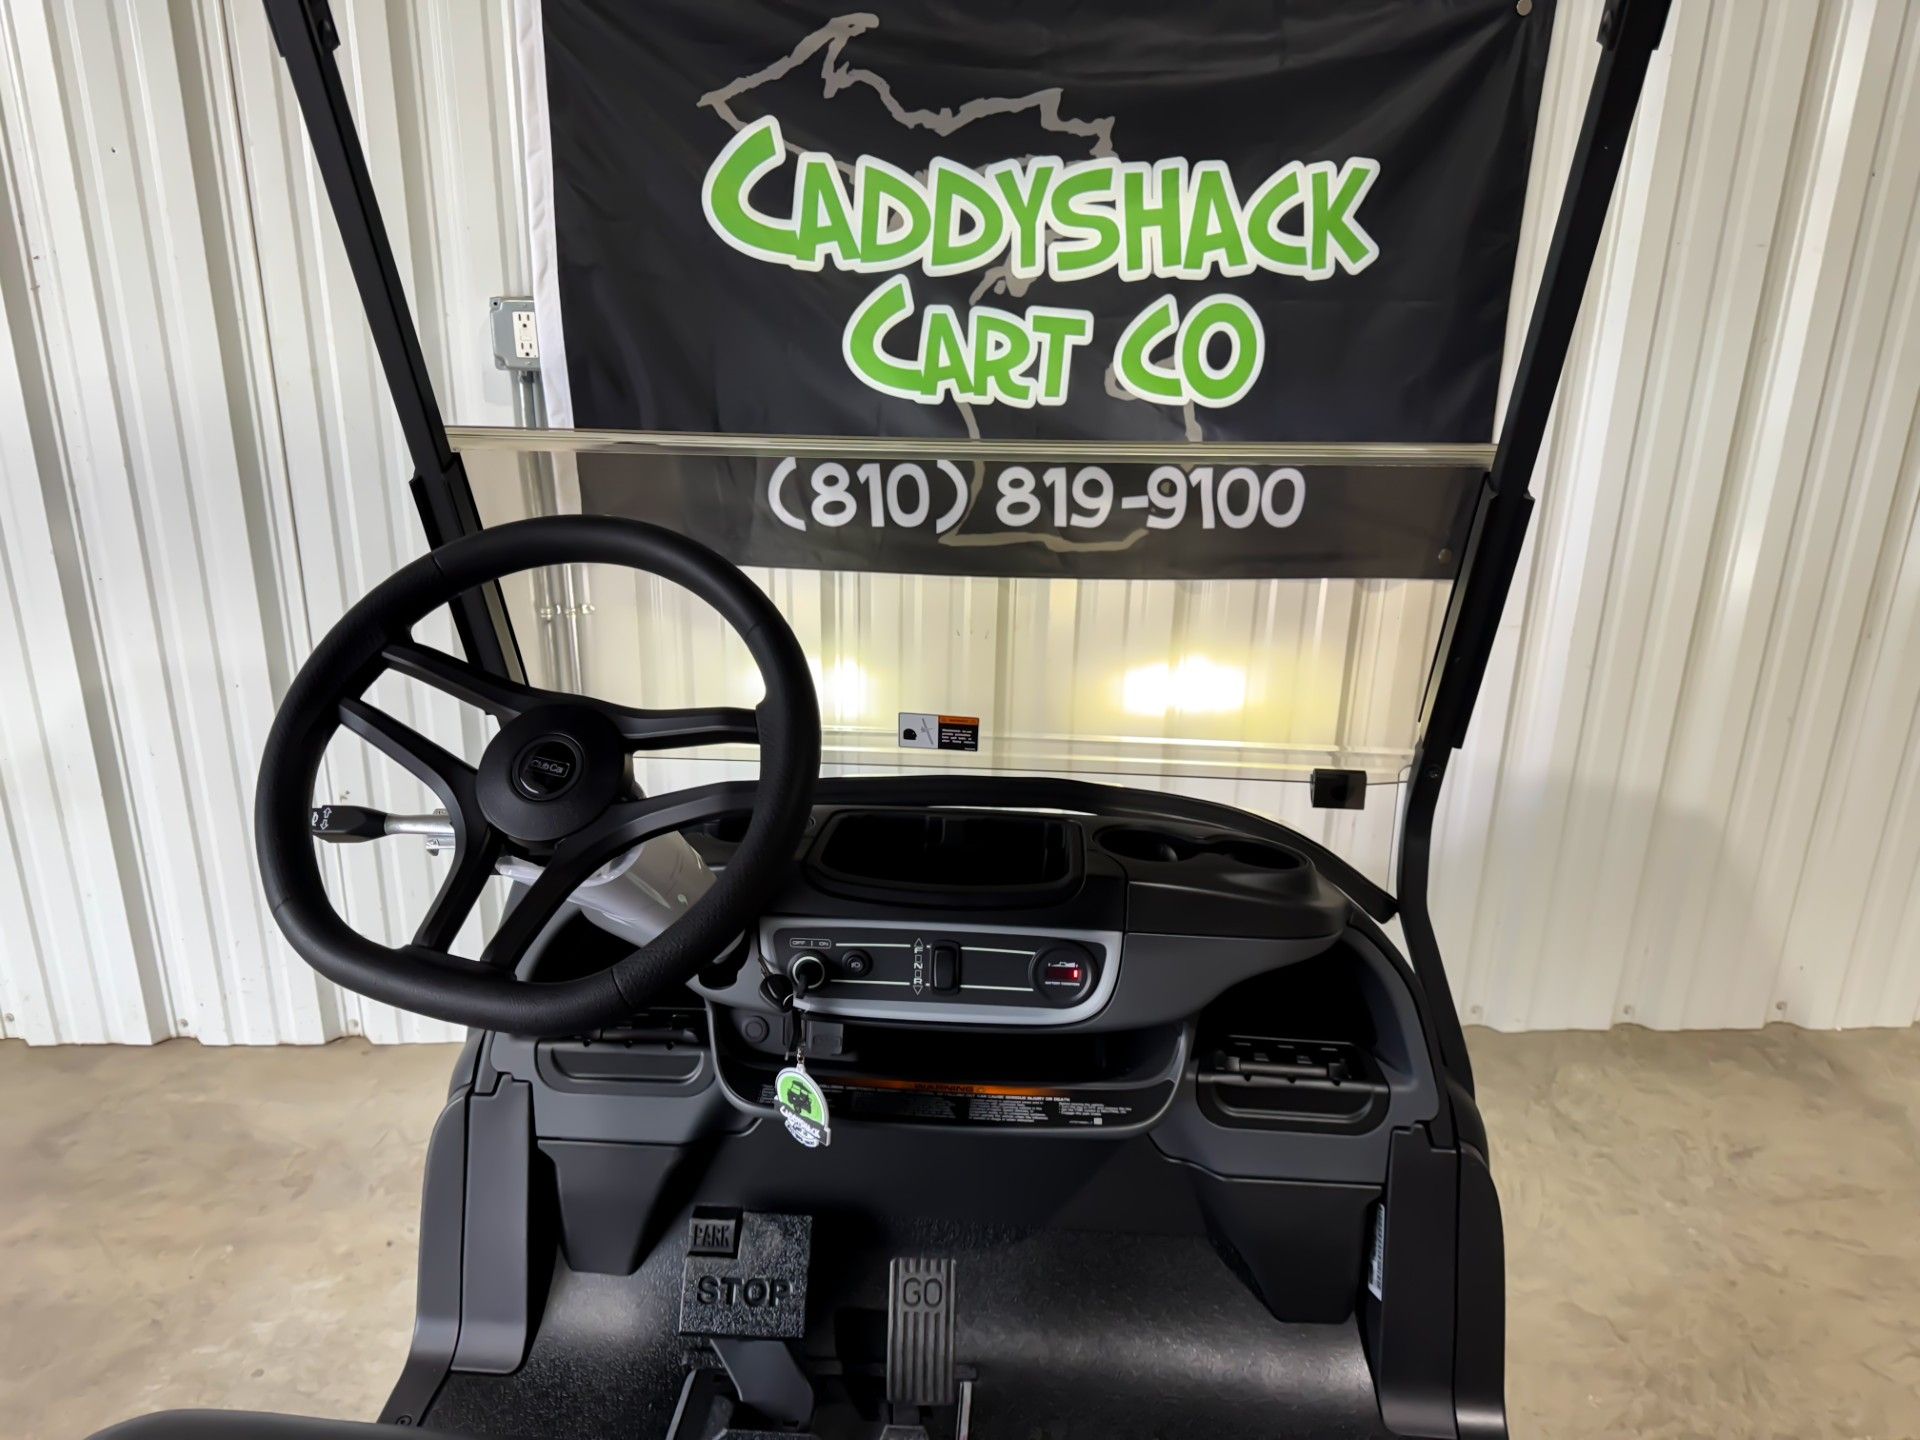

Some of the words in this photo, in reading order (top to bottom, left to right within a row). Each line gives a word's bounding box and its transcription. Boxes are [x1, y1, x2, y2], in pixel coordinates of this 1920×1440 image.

[701, 114, 1380, 281] CADDYSHACK
[842, 274, 1094, 408] CART
[1112, 293, 1266, 409] CO
[768, 457, 969, 534] (810)
[995, 466, 1306, 530] 819-9100
[694, 1223, 730, 1248] PARK
[700, 1276, 792, 1307] STOP
[903, 1277, 942, 1307] GO
